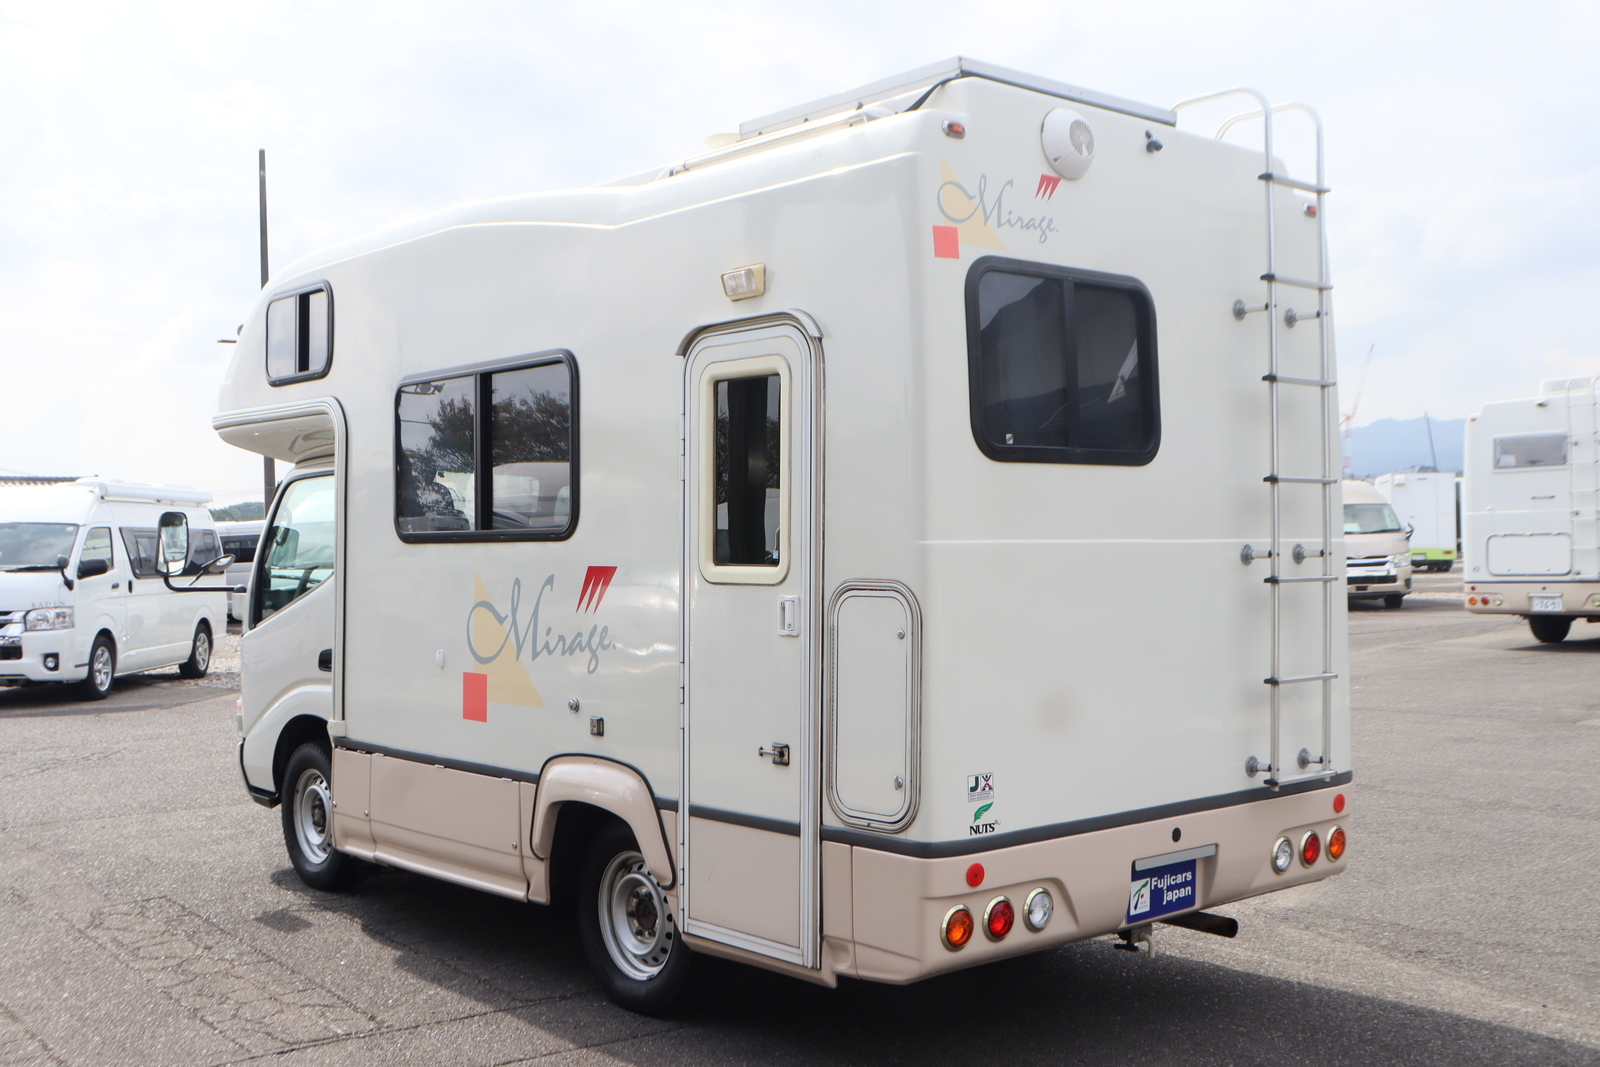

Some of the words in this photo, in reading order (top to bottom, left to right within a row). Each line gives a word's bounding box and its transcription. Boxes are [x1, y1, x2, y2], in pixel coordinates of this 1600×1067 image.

[969, 822, 995, 836] NUTS
[1151, 871, 1193, 890] Fujicars
[1162, 886, 1192, 905] japan
